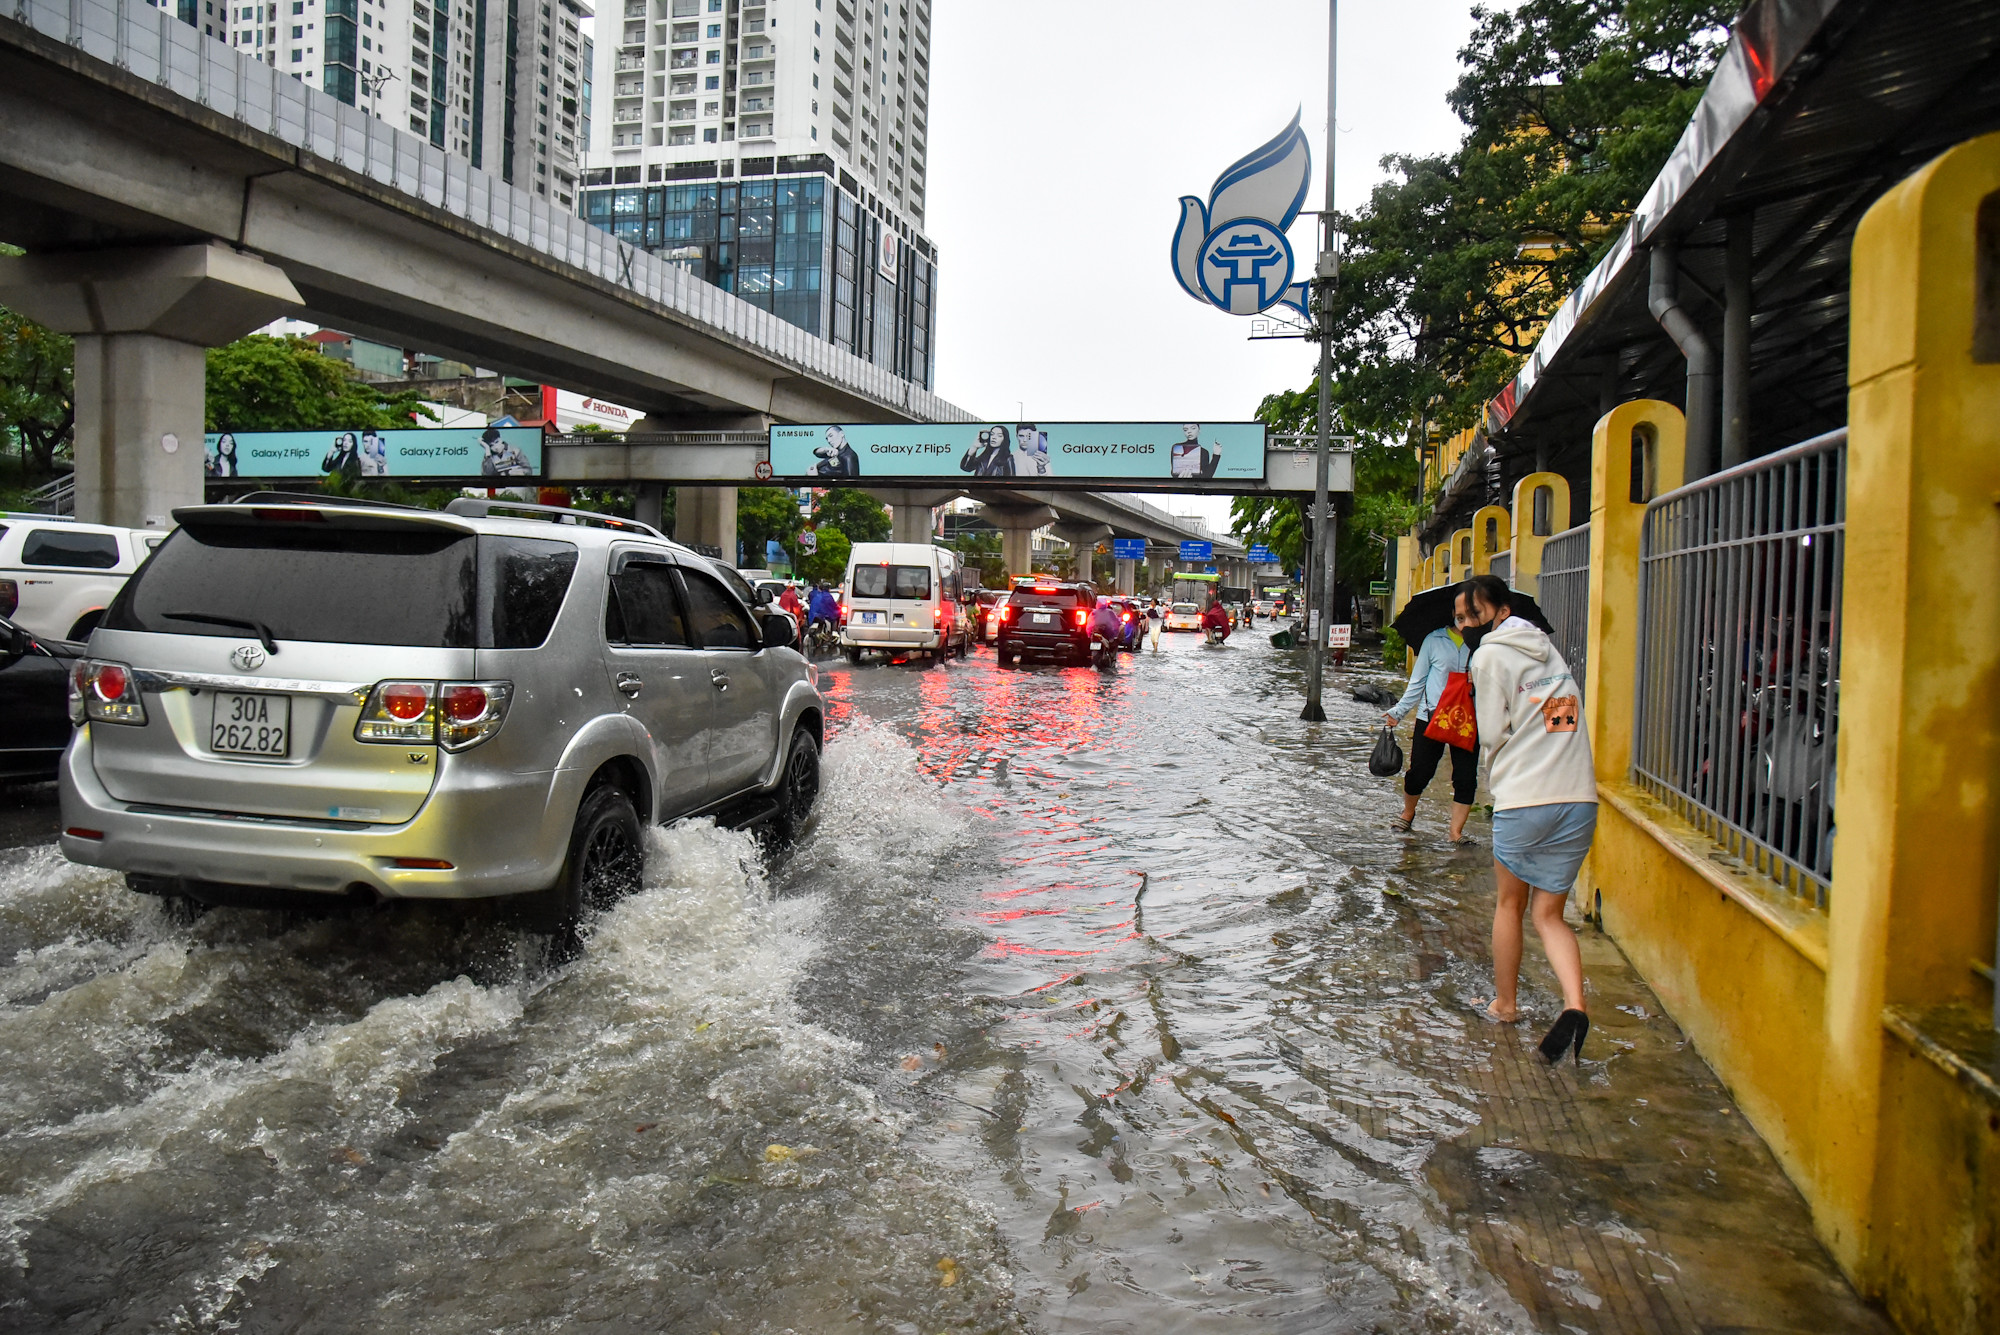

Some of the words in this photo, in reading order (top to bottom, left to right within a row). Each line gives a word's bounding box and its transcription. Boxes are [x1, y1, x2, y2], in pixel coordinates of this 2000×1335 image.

[593, 402, 629, 419] HONDA
[777, 430, 815, 438] SAMSUNG
[251, 449, 283, 459] Galaxy
[284, 448, 289, 457] Z
[290, 448, 310, 459] Flip5
[400, 447, 434, 458] Galaxy
[435, 447, 441, 456] Z
[443, 446, 469, 456] Fold5
[870, 444, 914, 456] Galaxy
[915, 444, 922, 454] Z
[924, 443, 952, 456] Flip5
[1062, 443, 1109, 456] Galaxy
[1110, 444, 1118, 454] Z
[1120, 443, 1155, 454] Fold5
[1518, 685, 1526, 695] A
[1525, 676, 1554, 690] SWEET
[231, 696, 269, 723] 30A
[214, 723, 284, 753] 262.82
